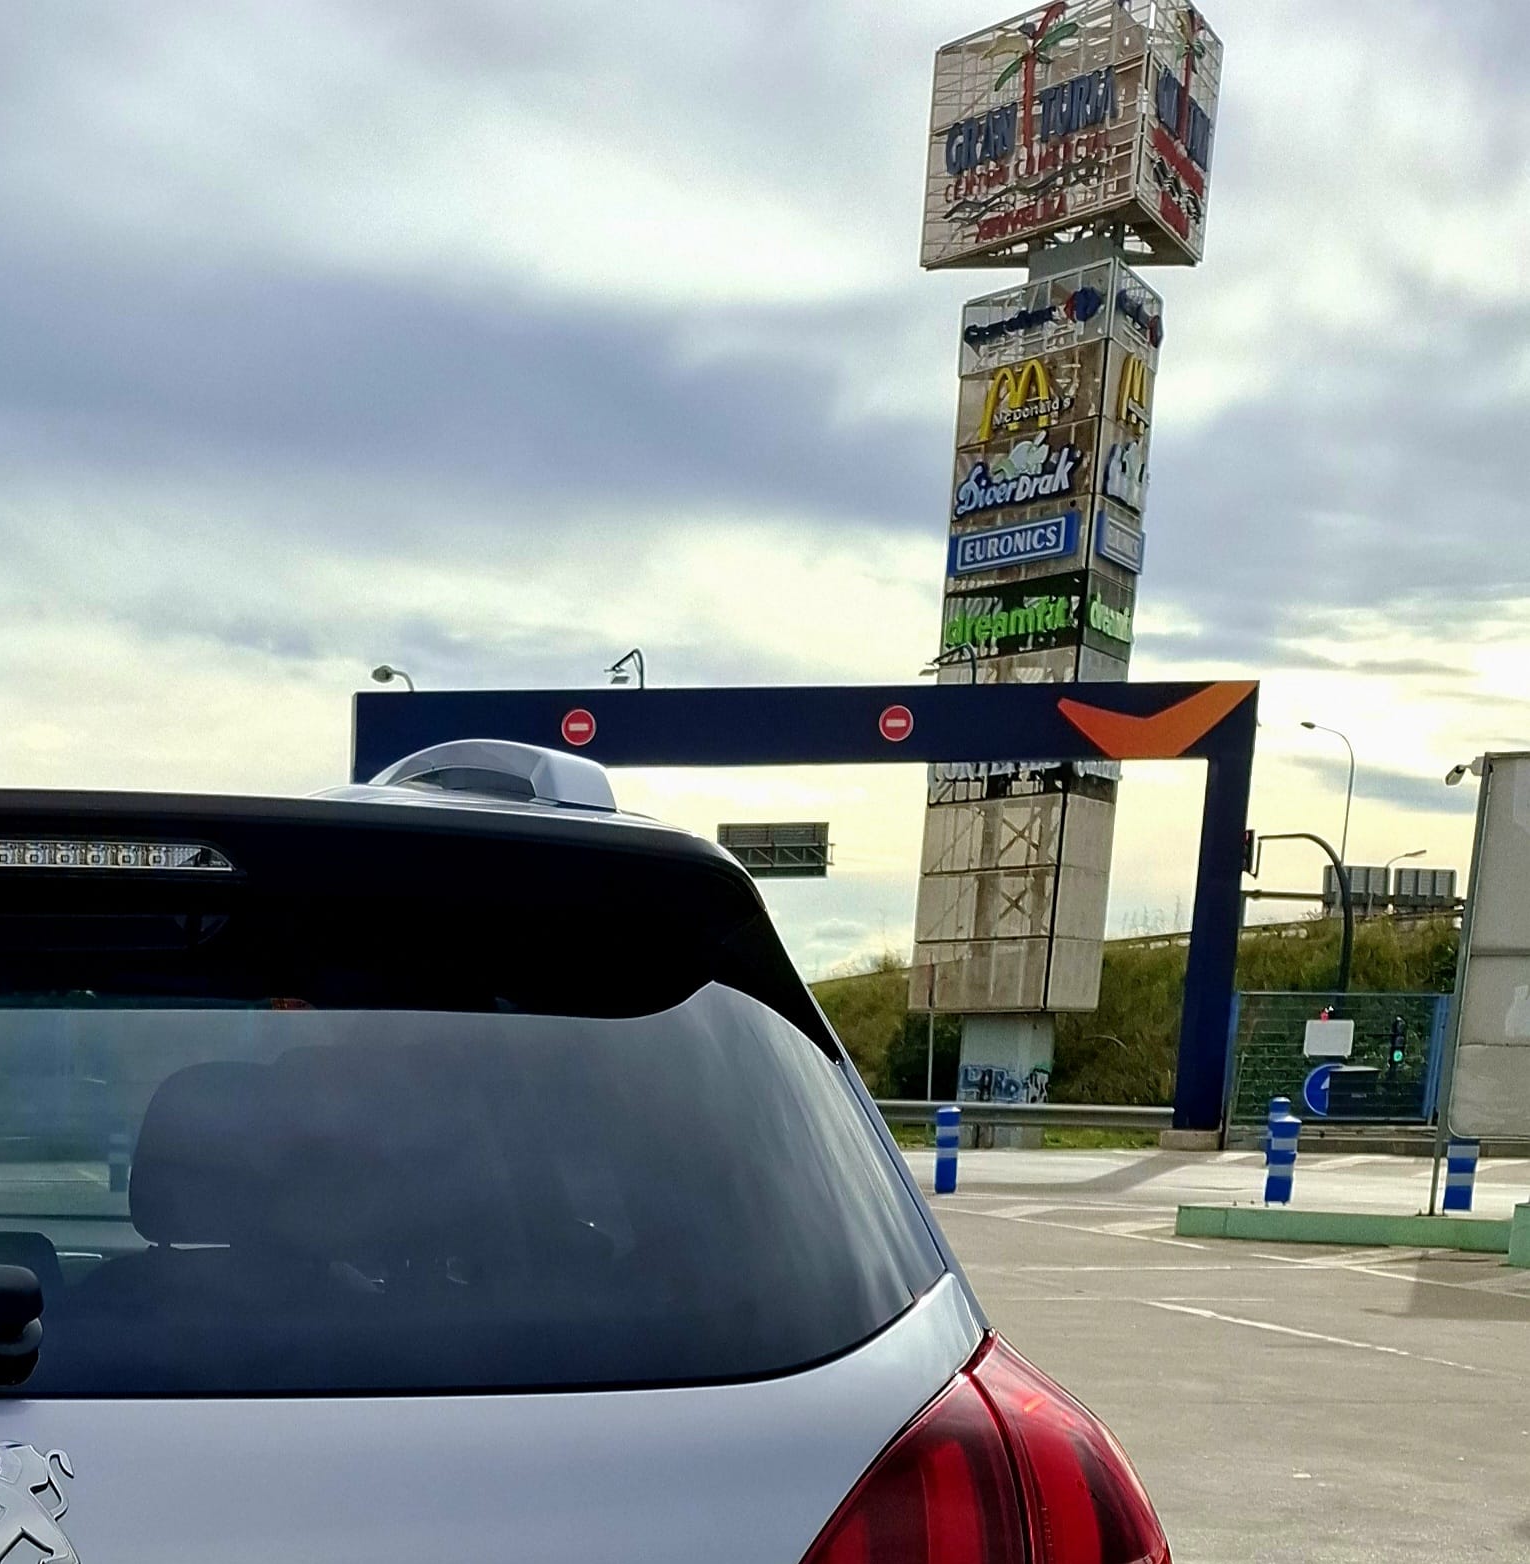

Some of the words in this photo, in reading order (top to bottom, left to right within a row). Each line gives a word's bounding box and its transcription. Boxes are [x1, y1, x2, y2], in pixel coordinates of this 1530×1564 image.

[945, 102, 1017, 175] GRAN
[963, 525, 1058, 563] EURONICS
[944, 595, 1070, 647] dreamfit
